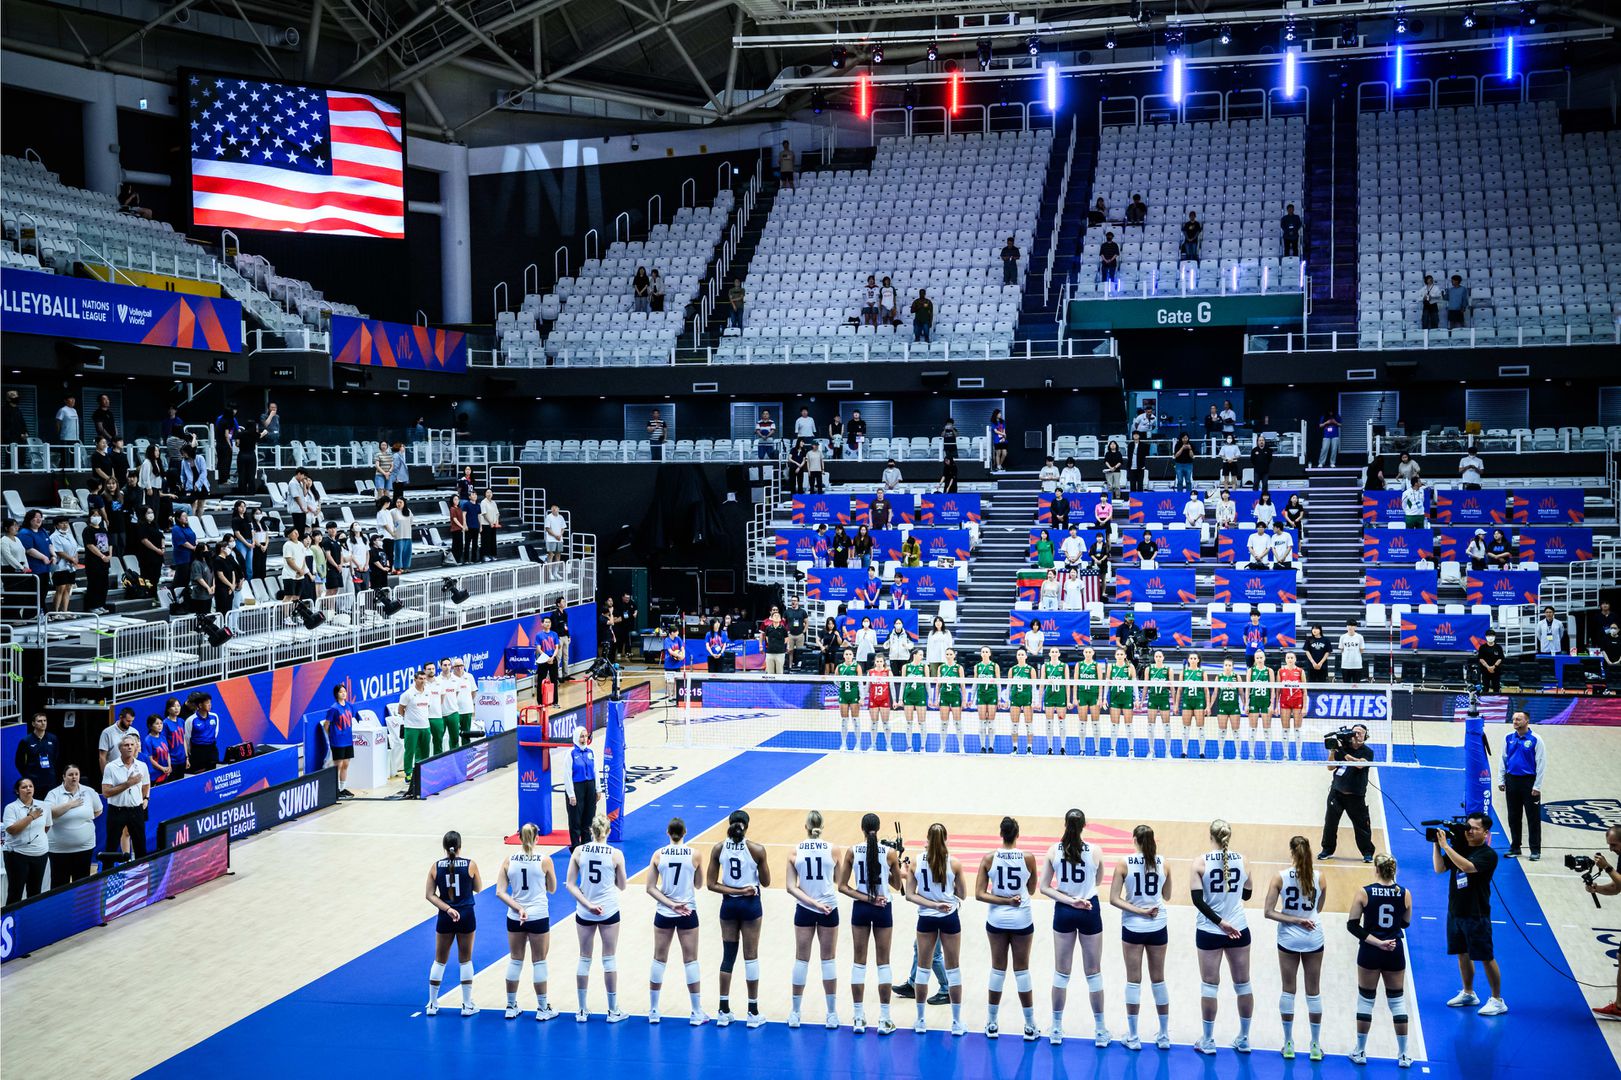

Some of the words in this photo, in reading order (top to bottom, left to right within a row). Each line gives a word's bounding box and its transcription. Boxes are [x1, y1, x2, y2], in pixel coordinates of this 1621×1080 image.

[0, 289, 80, 319] LLEYBALL
[82, 299, 110, 311] NATIONS
[128, 307, 152, 318] Volleyball
[1157, 309, 1192, 324] Gate
[1197, 301, 1212, 323] G
[82, 311, 107, 322] LEAGUE
[128, 316, 145, 326] World
[874, 685, 883, 696] 13
[1222, 690, 1235, 701] 23
[1315, 694, 1388, 718] STATES
[278, 780, 319, 820] SUWON
[196, 802, 256, 834] VOLLEYBALL
[229, 819, 256, 837] LEAGUE
[799, 842, 828, 850] DREWS
[521, 868, 529, 891] 1
[589, 860, 602, 884] 5
[668, 862, 682, 886] 7
[729, 857, 742, 880] 8
[804, 856, 824, 881] 11
[997, 866, 1021, 891] 15
[1060, 858, 1086, 883] 16
[1209, 867, 1241, 893] 22
[445, 873, 460, 897] 4
[1133, 872, 1159, 896] 18
[1371, 887, 1402, 897] HENTZ
[1378, 903, 1395, 928] 6
